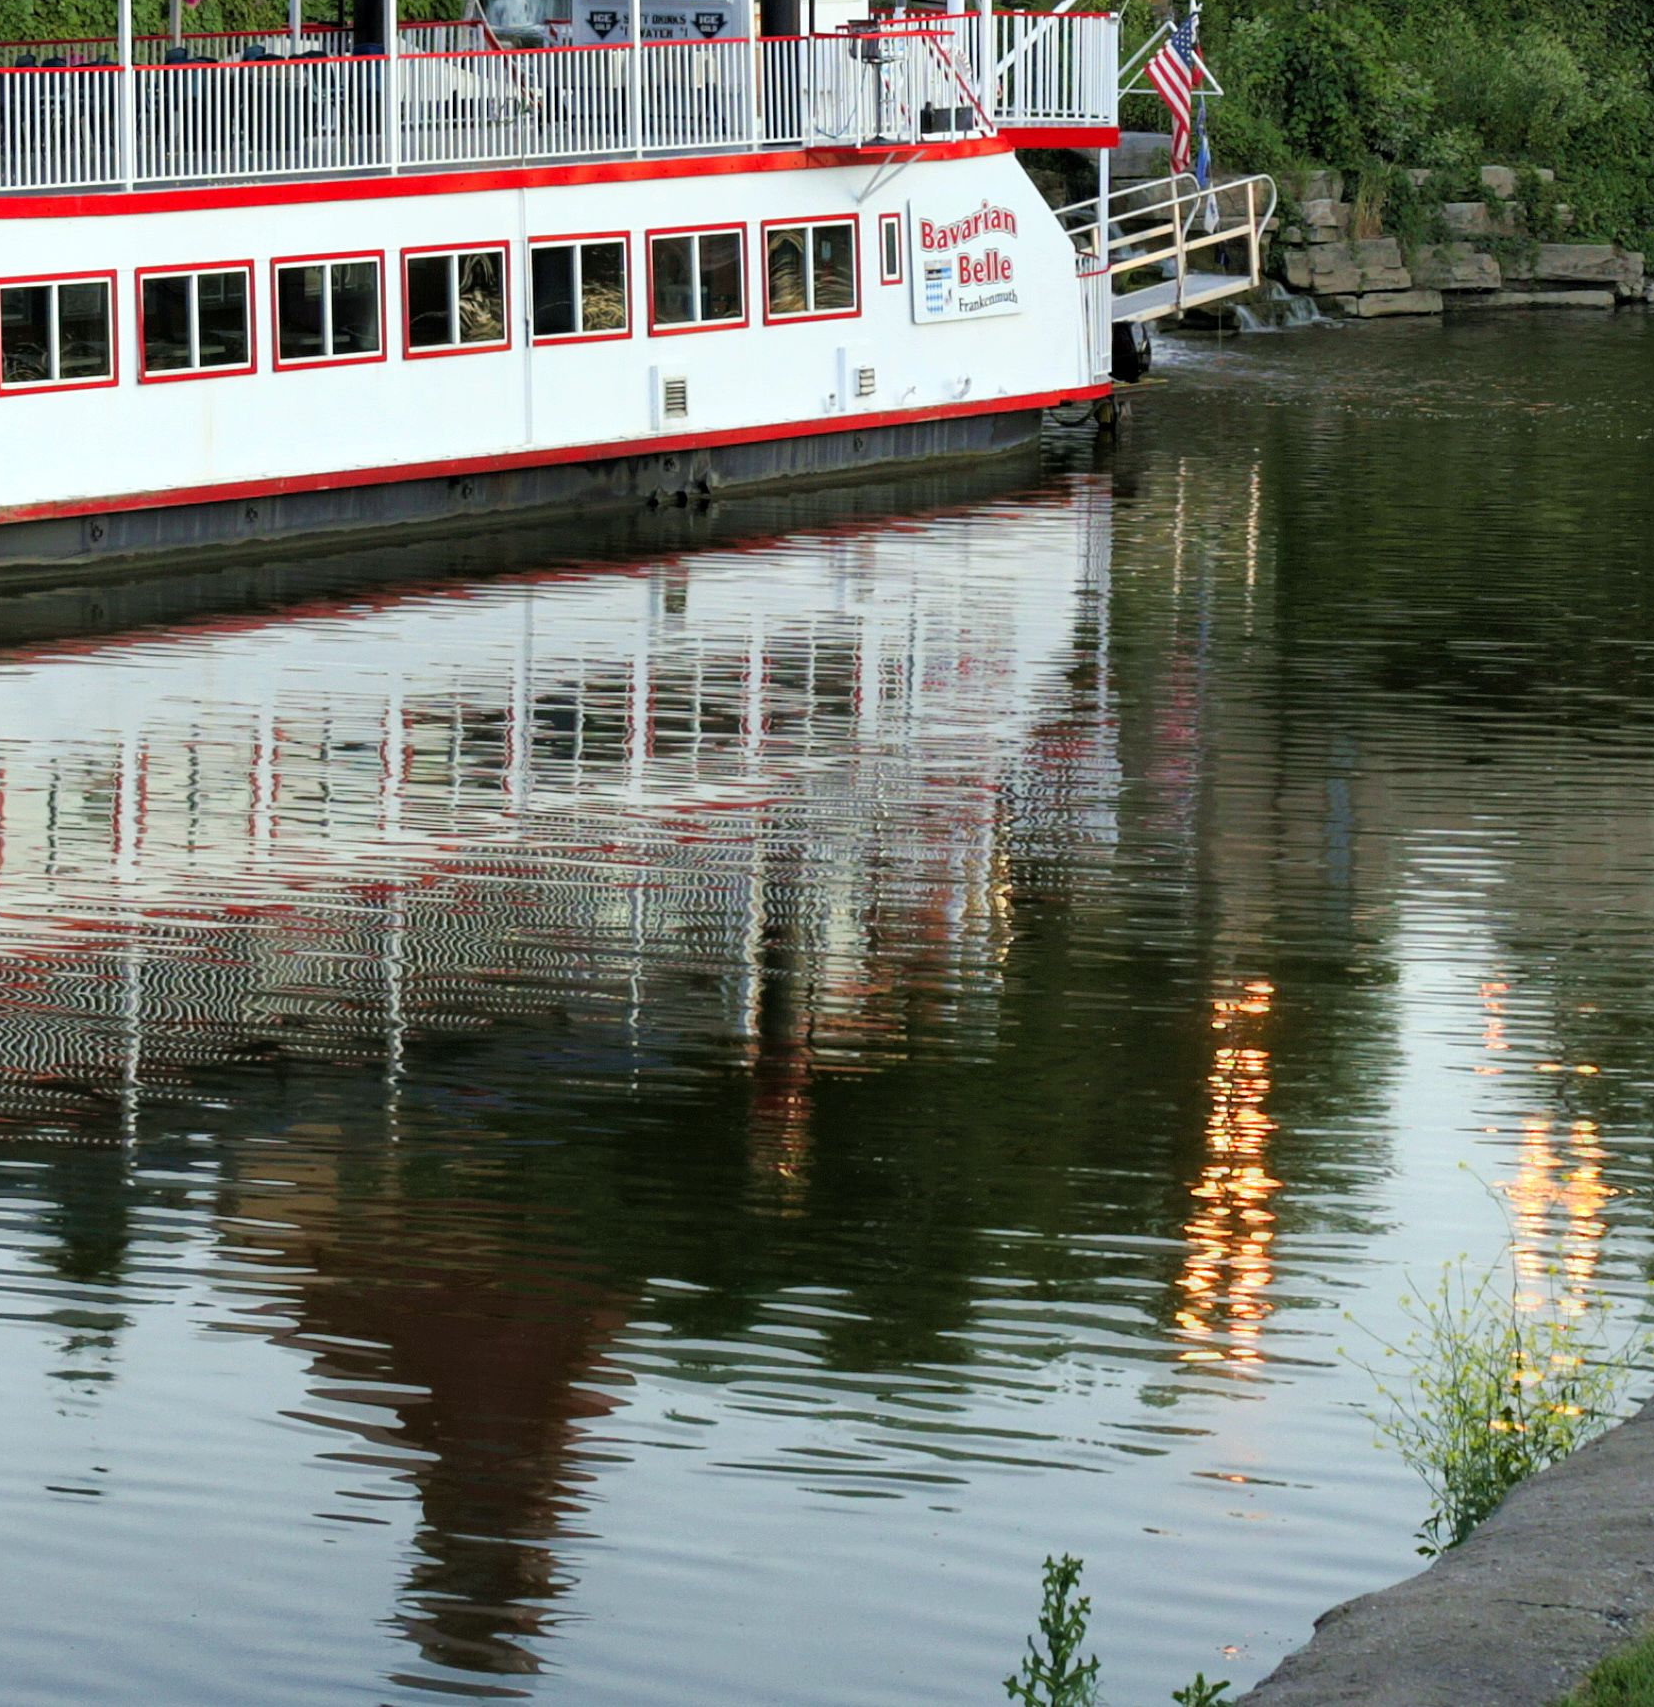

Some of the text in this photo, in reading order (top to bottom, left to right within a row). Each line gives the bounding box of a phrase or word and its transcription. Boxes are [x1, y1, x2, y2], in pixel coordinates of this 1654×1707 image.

[593, 13, 613, 23] ICE
[623, 14, 687, 25] ST DRINKS
[699, 14, 719, 24] ICE
[920, 201, 1017, 250] Bavarian
[958, 249, 1012, 286] Belle
[958, 289, 1018, 312] Frankenmuth
